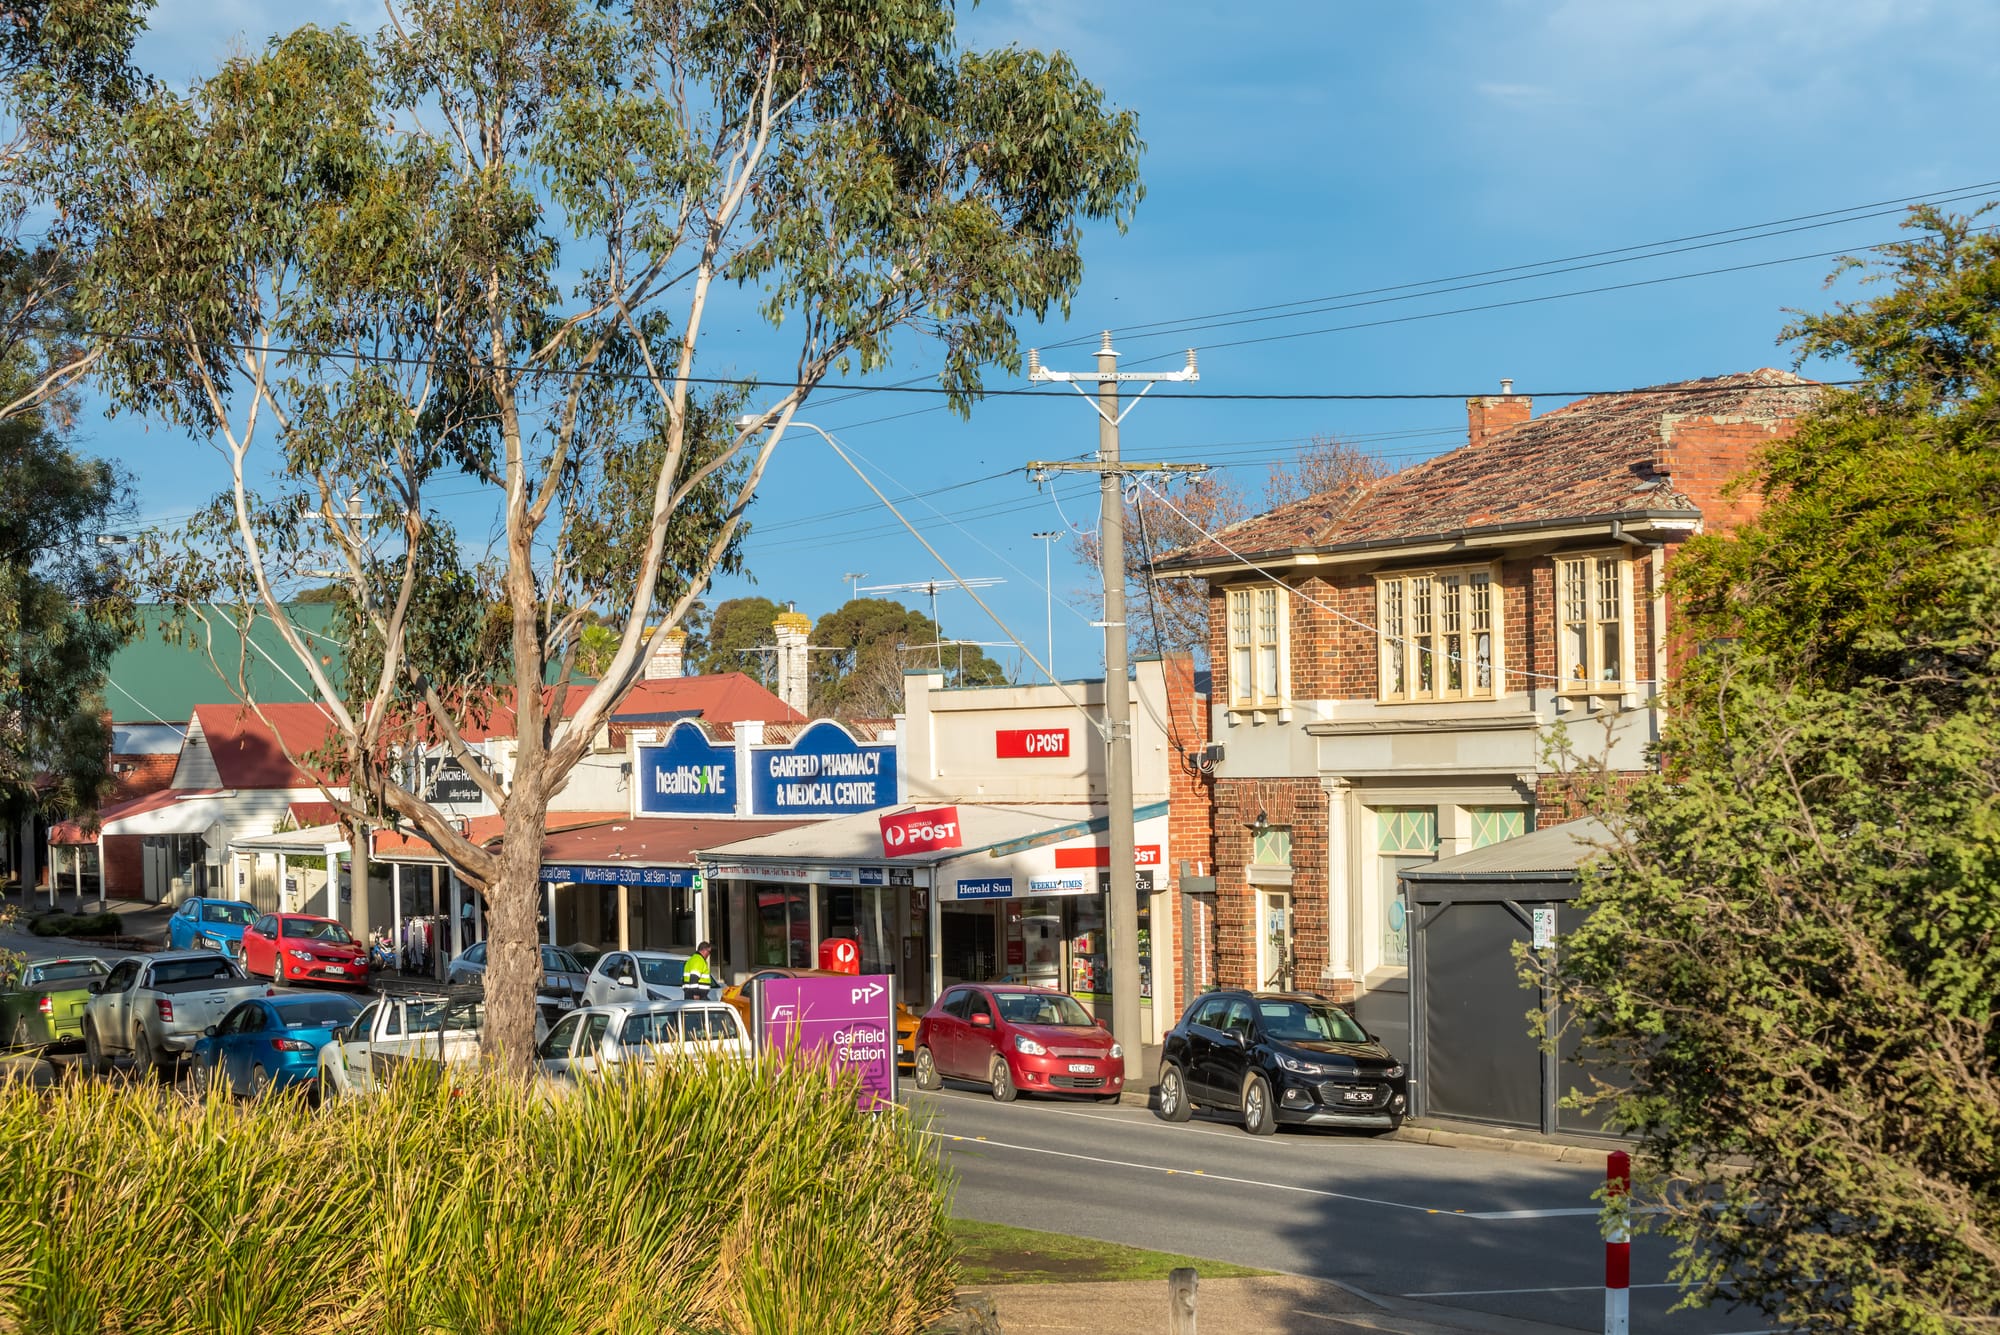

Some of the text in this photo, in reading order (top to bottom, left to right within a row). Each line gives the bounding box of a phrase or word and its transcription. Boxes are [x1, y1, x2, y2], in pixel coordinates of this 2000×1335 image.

[1036, 733, 1065, 752] POST
[770, 752, 880, 777] GARFIELD PHARMACY
[777, 782, 875, 806] & MEDICAL CENTRE
[908, 822, 956, 843] POST
[1134, 850, 1156, 862] OST
[540, 867, 570, 879] edical Centre
[620, 869, 640, 884] 5:30pm
[644, 870, 653, 883] Sat
[653, 870, 665, 883] 9am
[669, 872, 681, 886] 1pm
[960, 883, 1011, 894] Herald Sun
[1030, 880, 1082, 889] WEEKLY TIMES
[1135, 881, 1151, 889] GE
[833, 1029, 885, 1045] Garfield
[839, 1047, 886, 1061] Station
